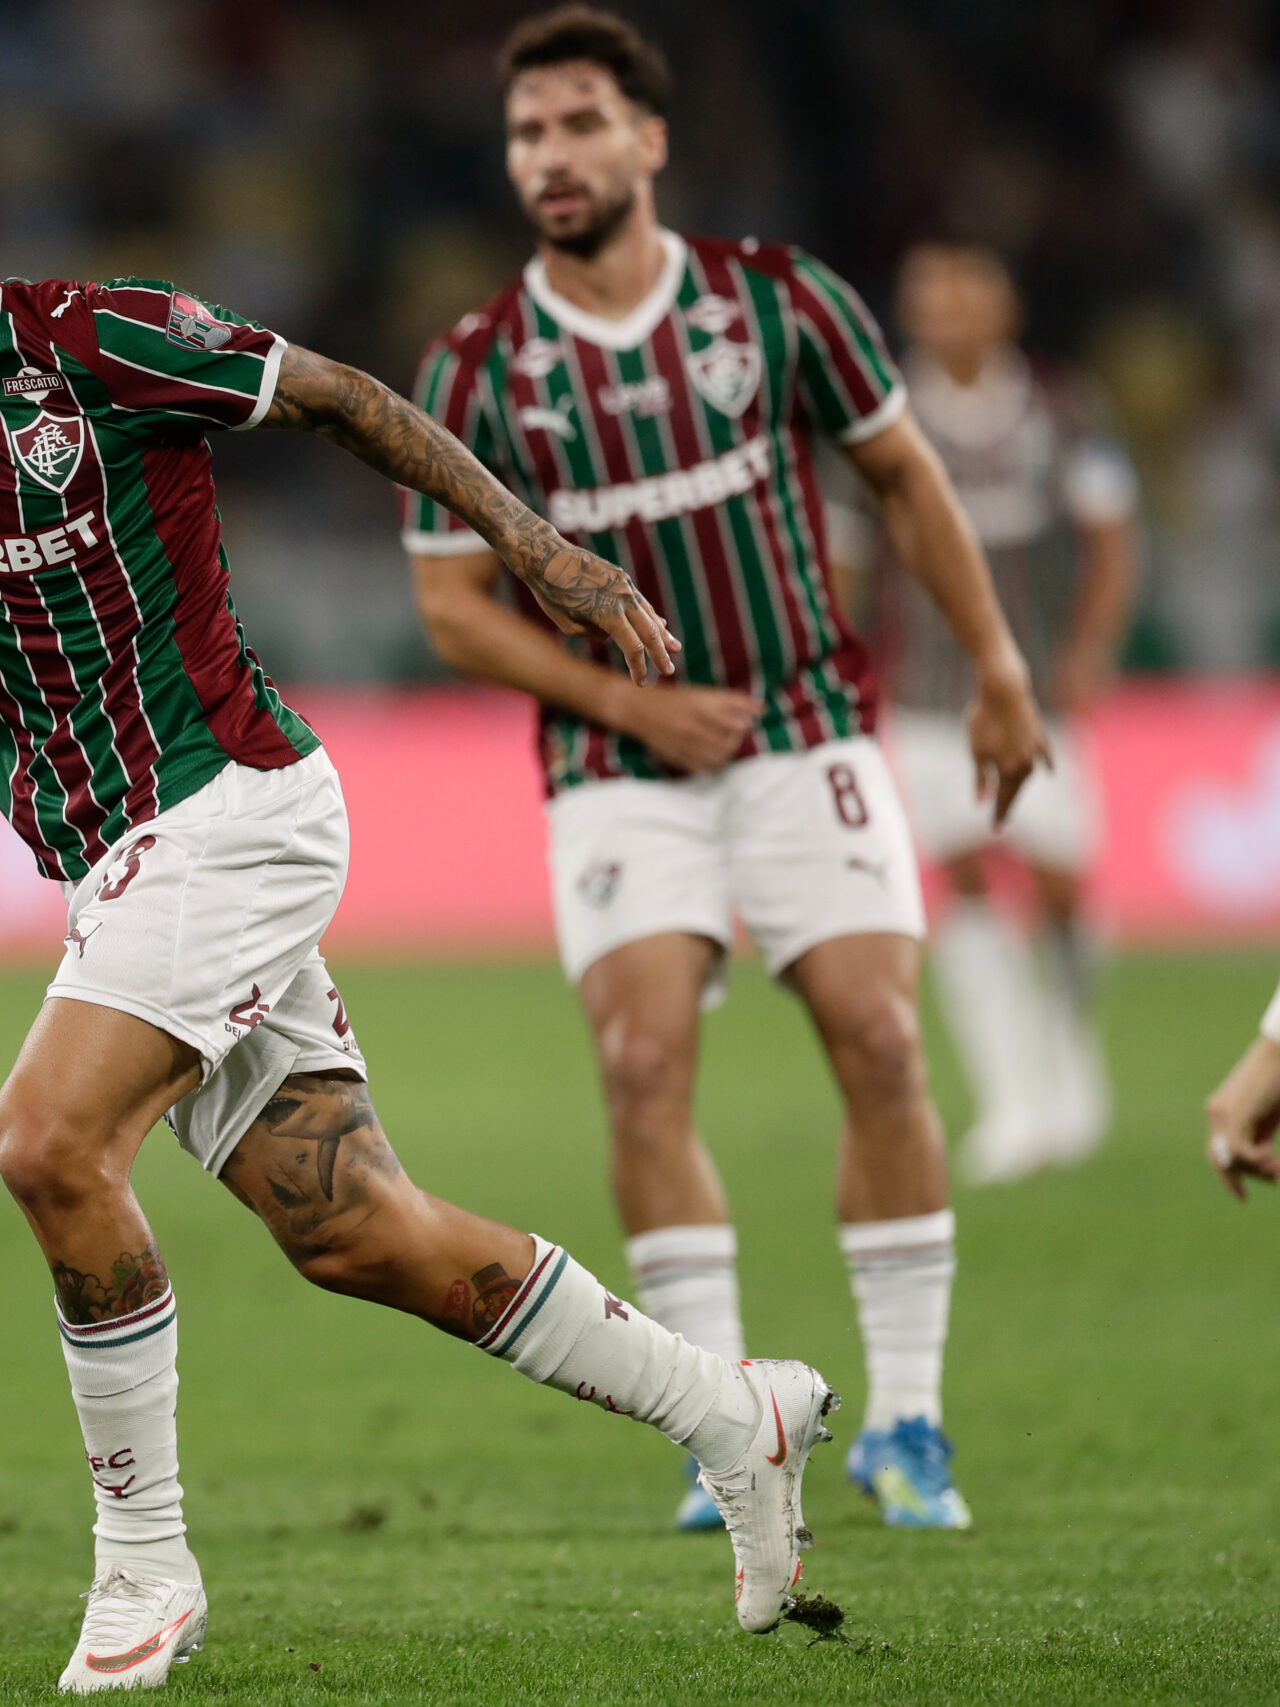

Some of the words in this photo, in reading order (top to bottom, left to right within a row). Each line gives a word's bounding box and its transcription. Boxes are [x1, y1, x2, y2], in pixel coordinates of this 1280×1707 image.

[6, 376, 59, 393] FRESCATTO
[547, 436, 770, 532] SUPERBET
[827, 763, 868, 828] 8
